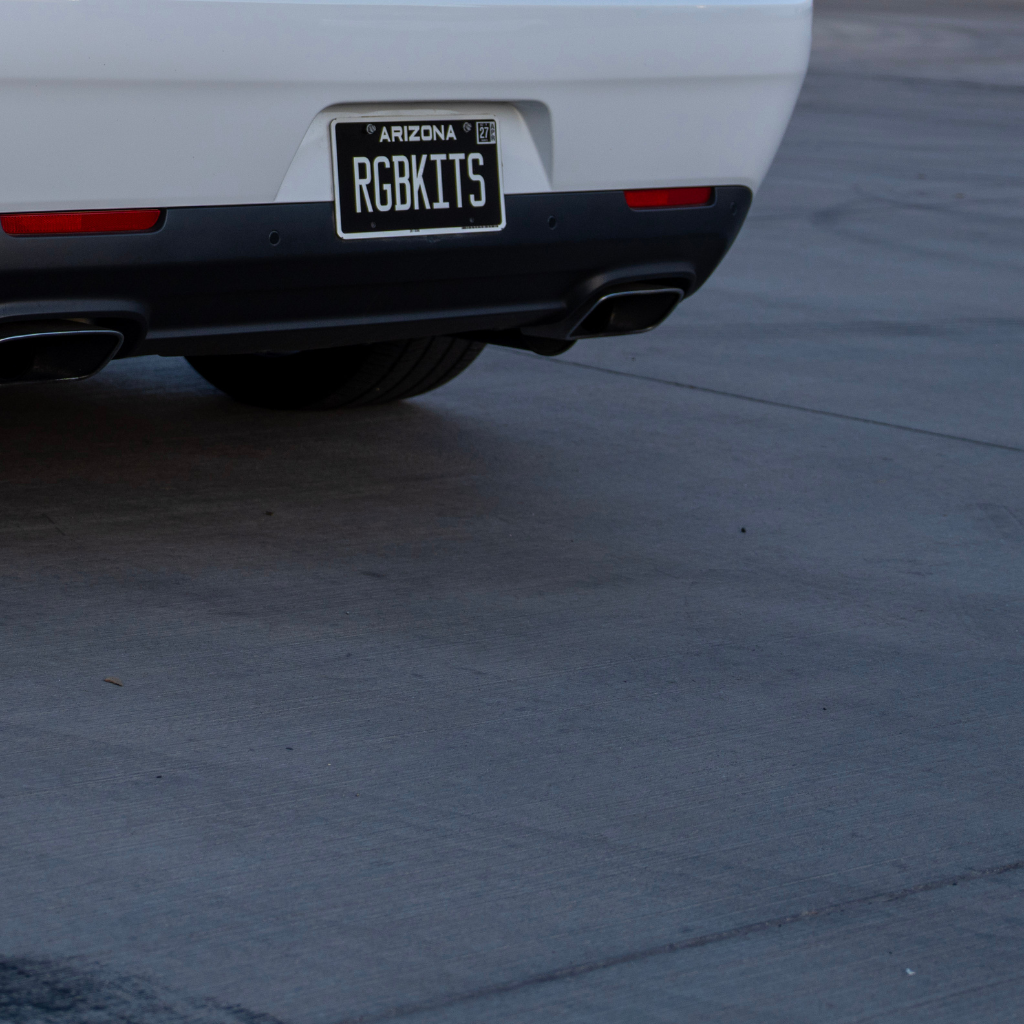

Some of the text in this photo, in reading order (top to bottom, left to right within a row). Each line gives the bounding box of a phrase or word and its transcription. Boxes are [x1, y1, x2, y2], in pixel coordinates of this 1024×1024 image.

[380, 125, 457, 142] ARIZONA
[479, 126, 489, 138] 27
[353, 152, 486, 213] RGBKITS
